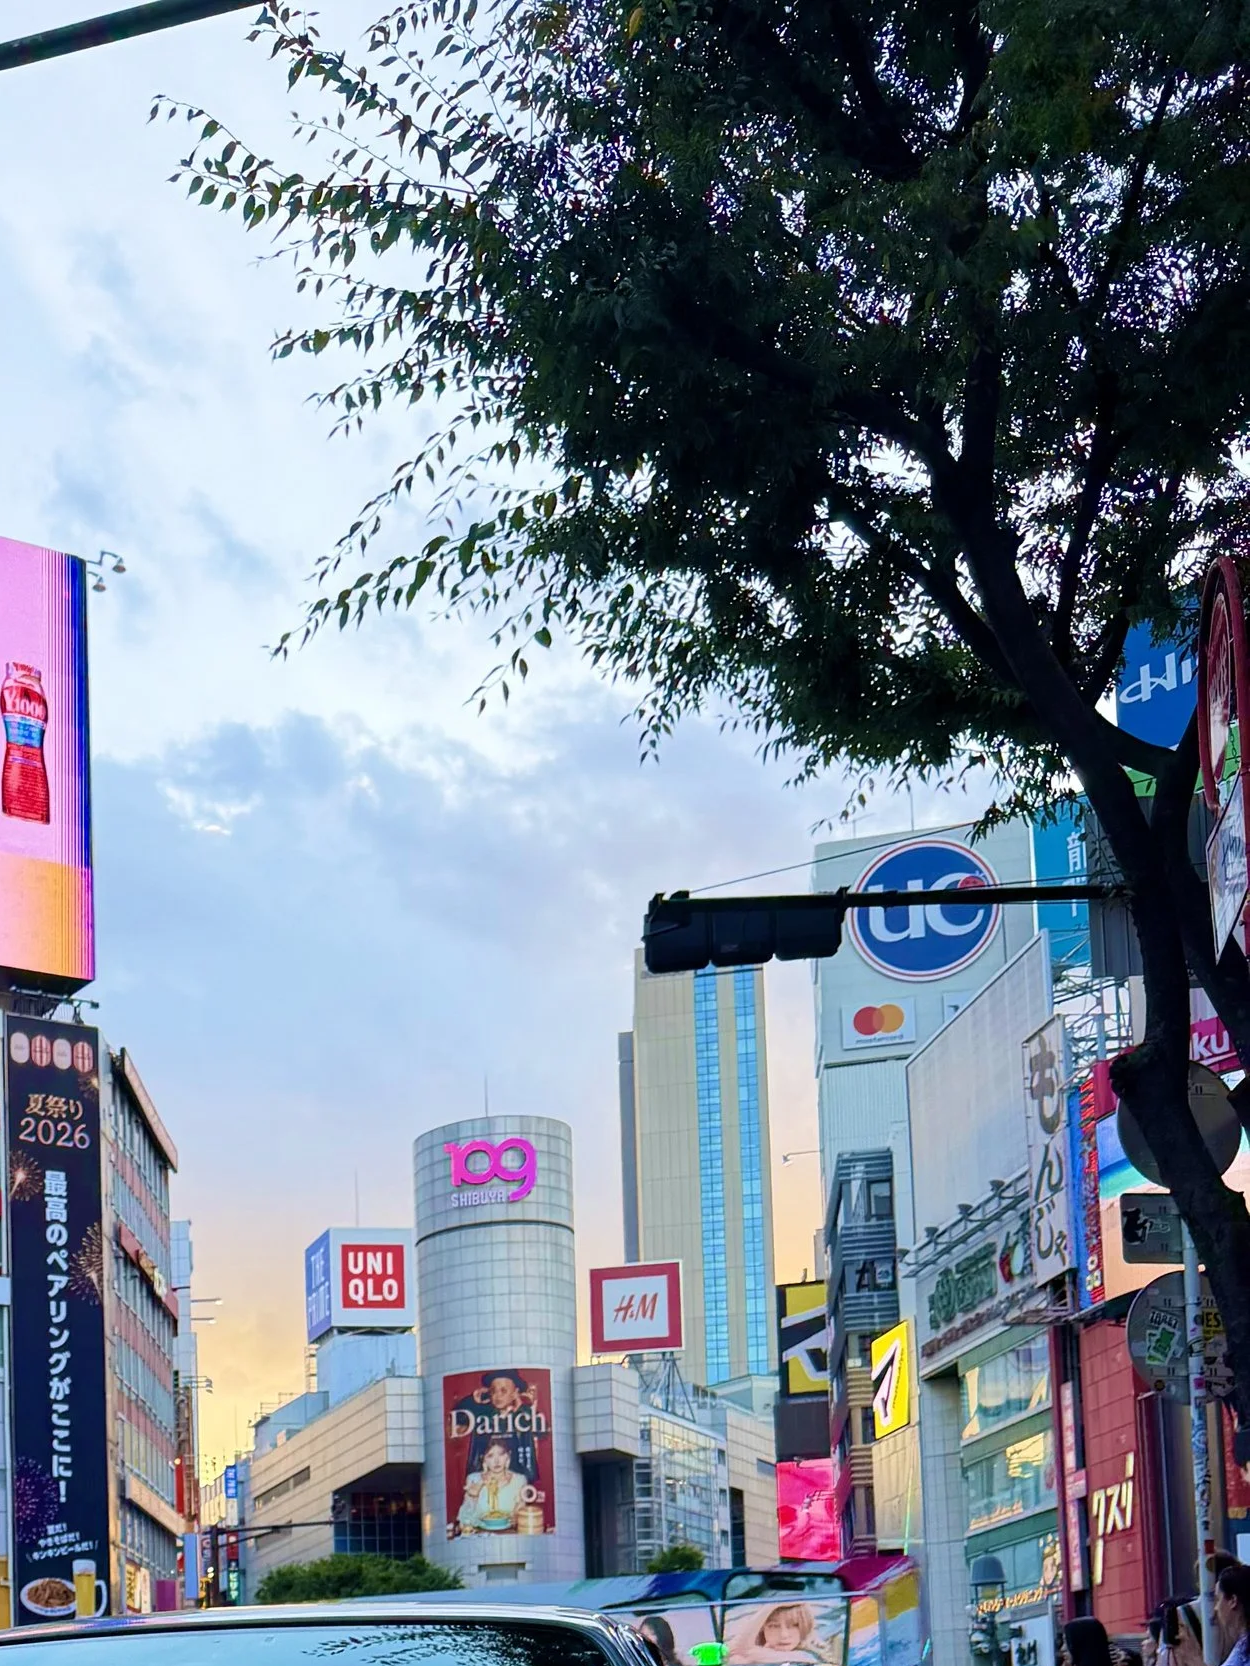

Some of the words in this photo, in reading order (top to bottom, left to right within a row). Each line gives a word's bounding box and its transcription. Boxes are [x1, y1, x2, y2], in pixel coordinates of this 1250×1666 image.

[25, 1093, 83, 1120] 夏祭り
[18, 1117, 91, 1149] 2026
[443, 1137, 538, 1203] 109
[450, 1190, 506, 1208] SHIBUYA
[348, 1251, 394, 1275] UNI
[348, 1278, 399, 1305] QLO
[613, 1292, 659, 1323] H&M
